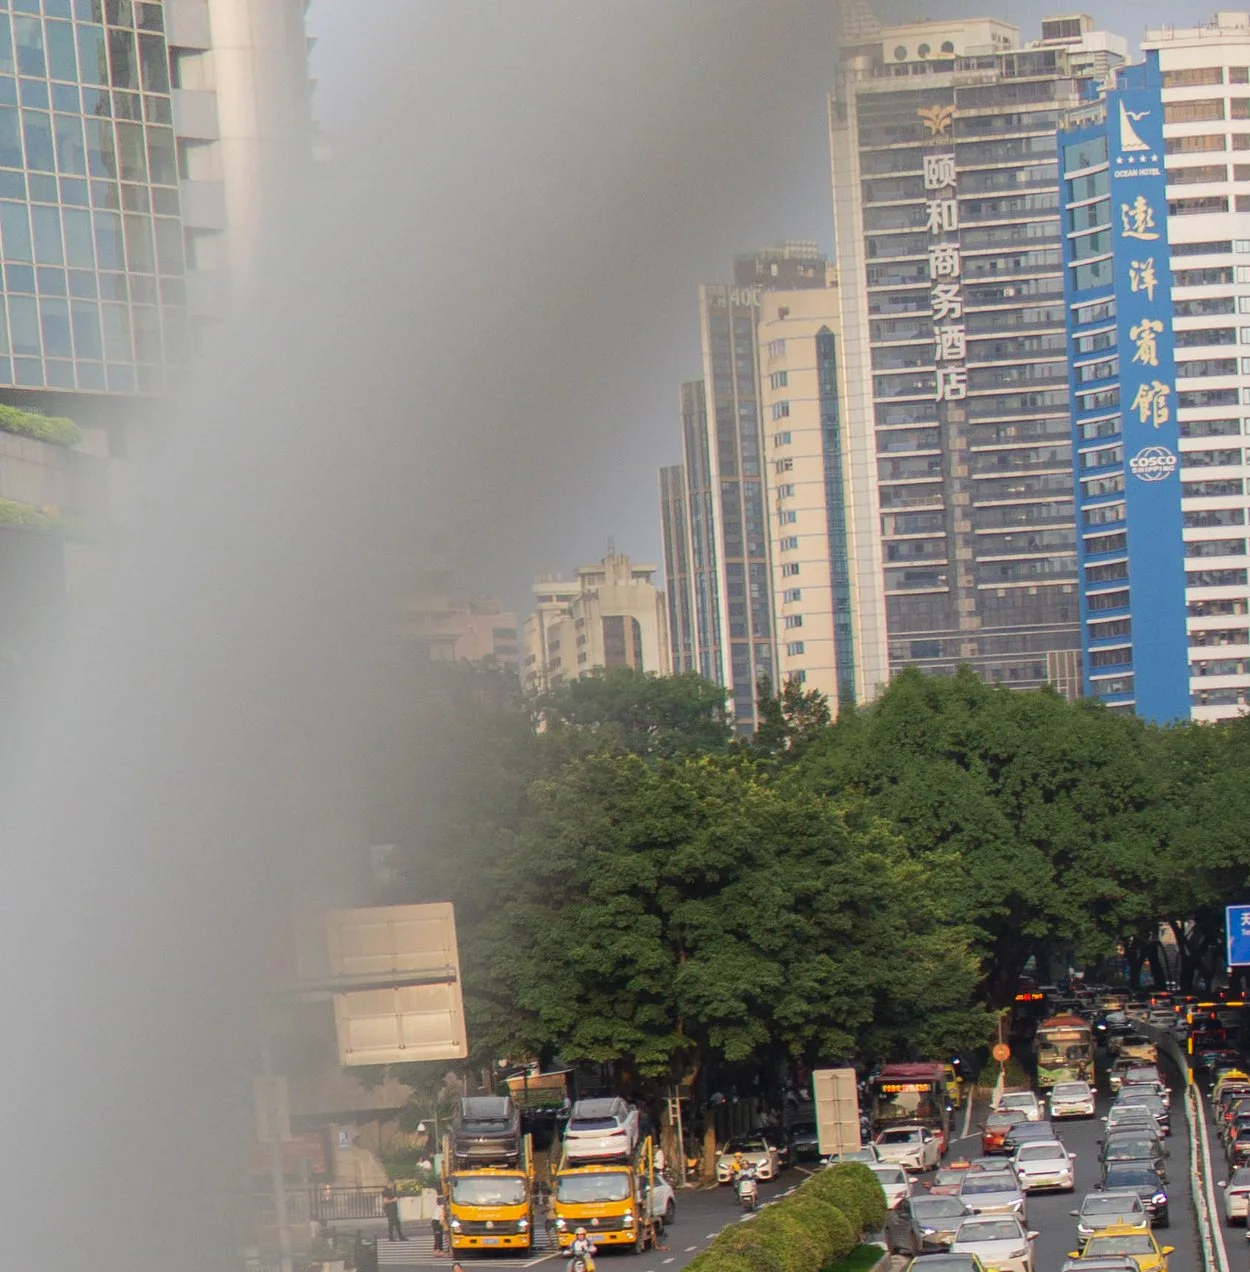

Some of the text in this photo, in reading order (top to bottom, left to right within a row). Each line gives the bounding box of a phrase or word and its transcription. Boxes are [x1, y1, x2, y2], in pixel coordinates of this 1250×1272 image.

[1114, 168, 1161, 178] OCEAN HOTEL
[923, 153, 967, 402] 颐和商务酒店
[1120, 196, 1171, 428] 遠洋賓館
[1129, 455, 1177, 467] COSCO
[1131, 465, 1175, 474] SHIPPING
